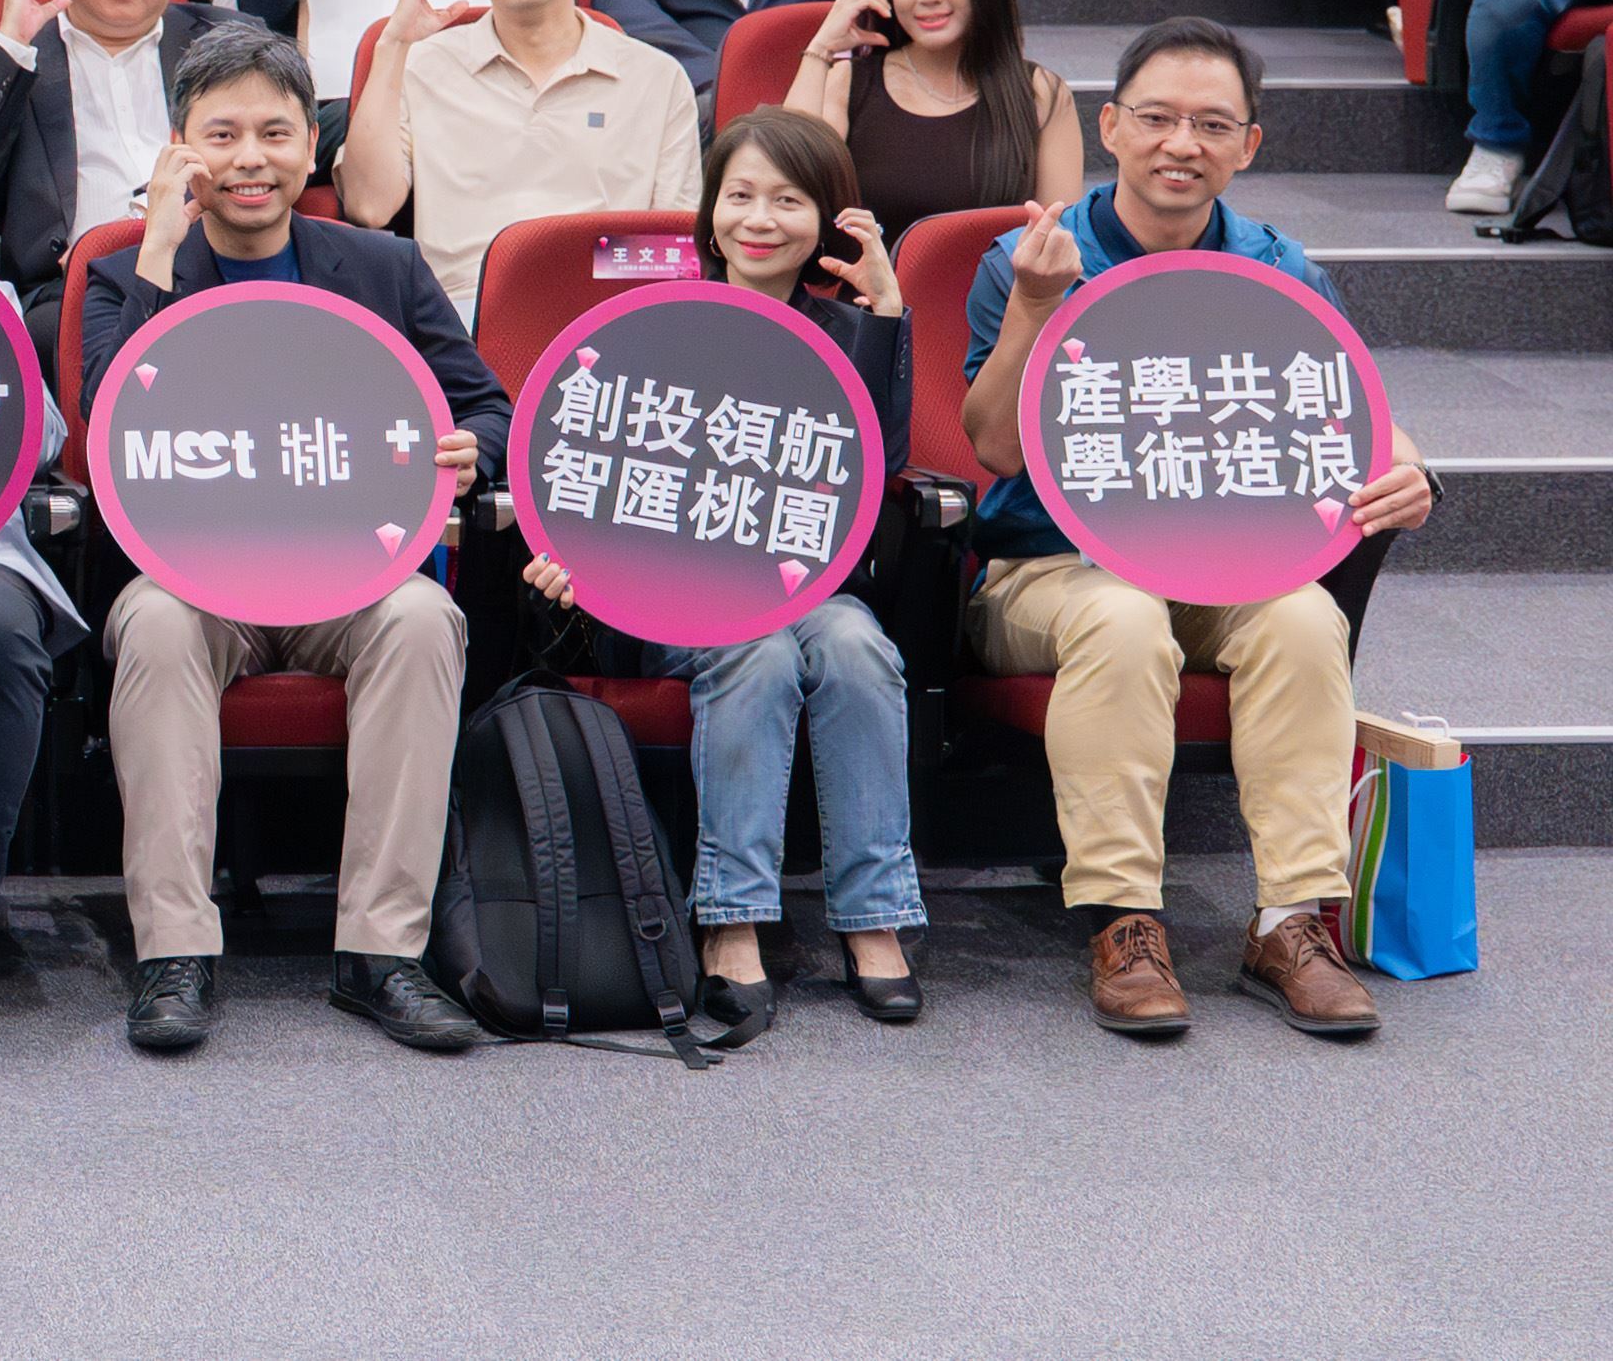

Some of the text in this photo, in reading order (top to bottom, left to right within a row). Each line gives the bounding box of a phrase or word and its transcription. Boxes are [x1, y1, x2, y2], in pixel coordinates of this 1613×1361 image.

[550, 365, 855, 486] 創投領航
[1055, 350, 1353, 427] 產學共創
[538, 438, 841, 566] 智匯桃園
[1060, 424, 1365, 503] 學術造浪
